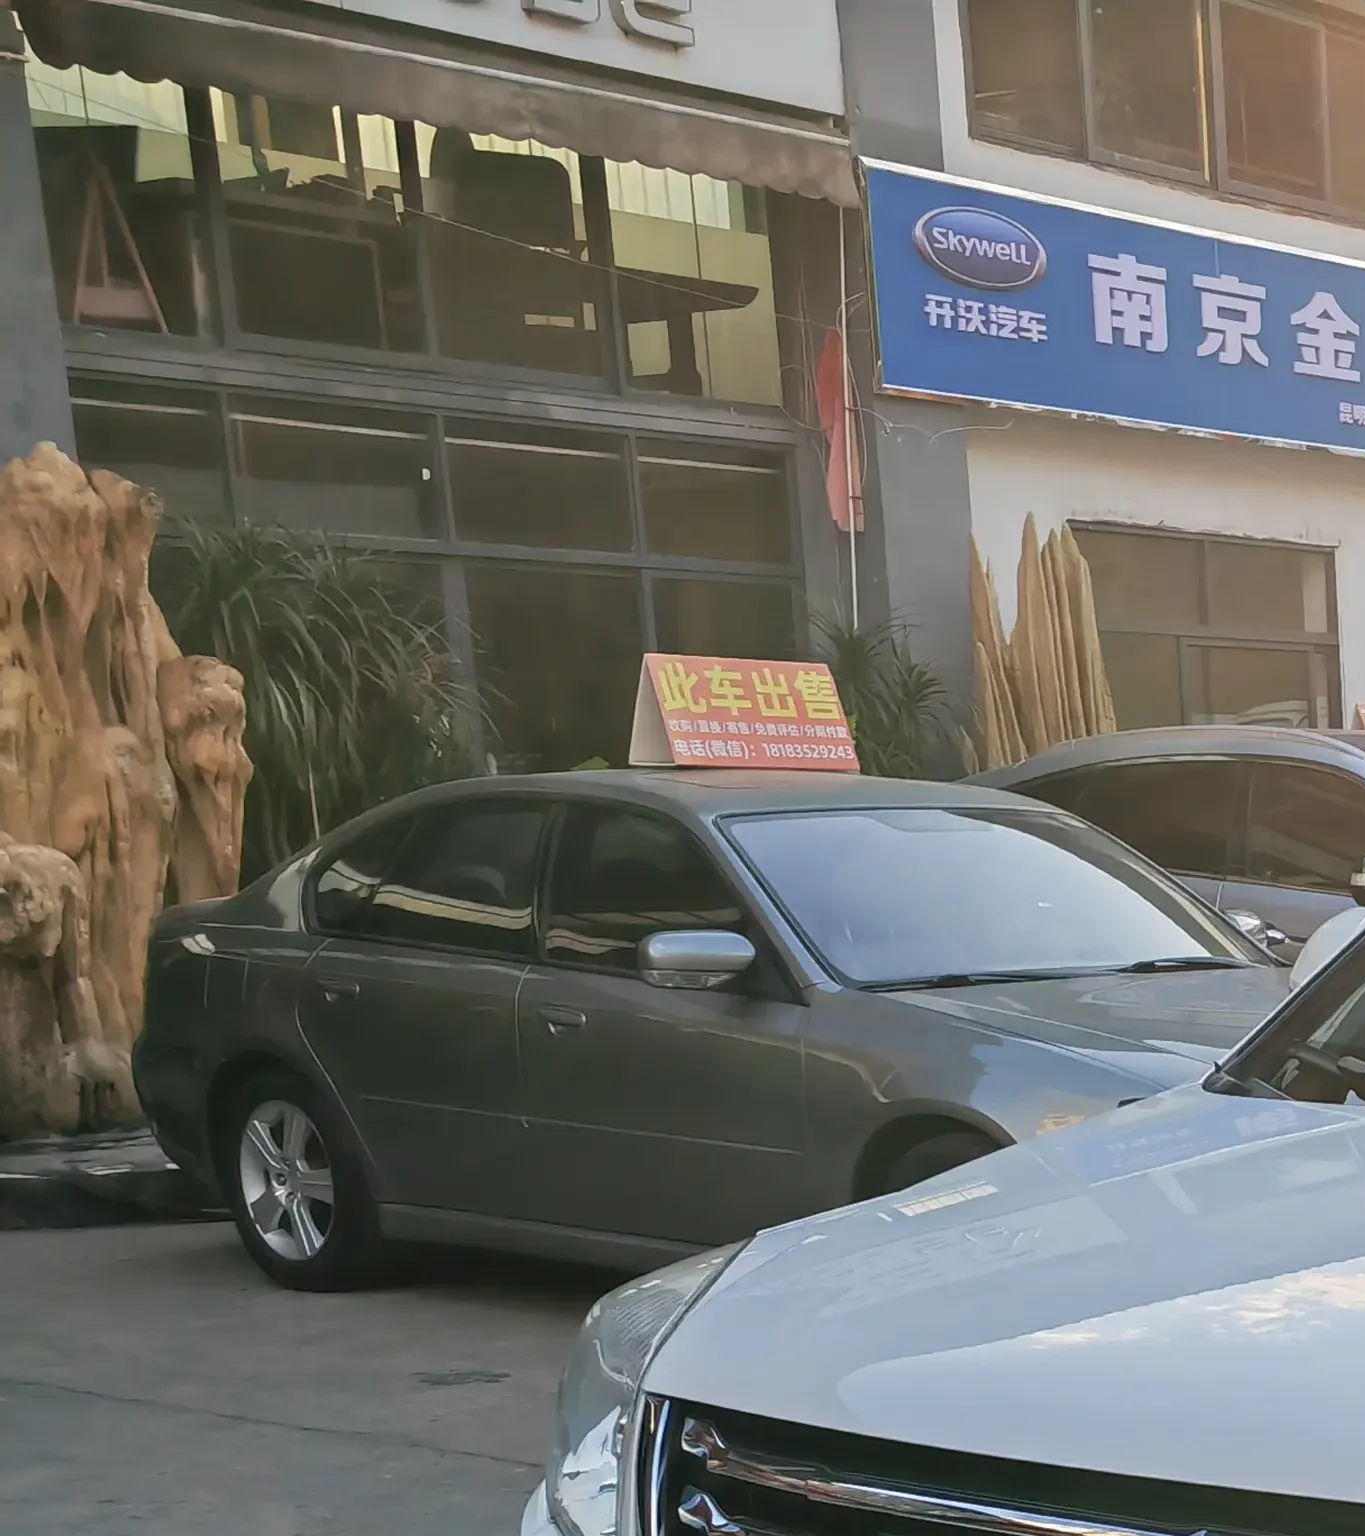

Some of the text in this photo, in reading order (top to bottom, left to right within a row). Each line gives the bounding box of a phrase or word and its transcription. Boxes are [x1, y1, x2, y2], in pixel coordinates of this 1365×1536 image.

[932, 226, 1032, 266] Skywell
[923, 293, 1049, 343] 开沃汽车
[657, 661, 842, 720] 此车出售
